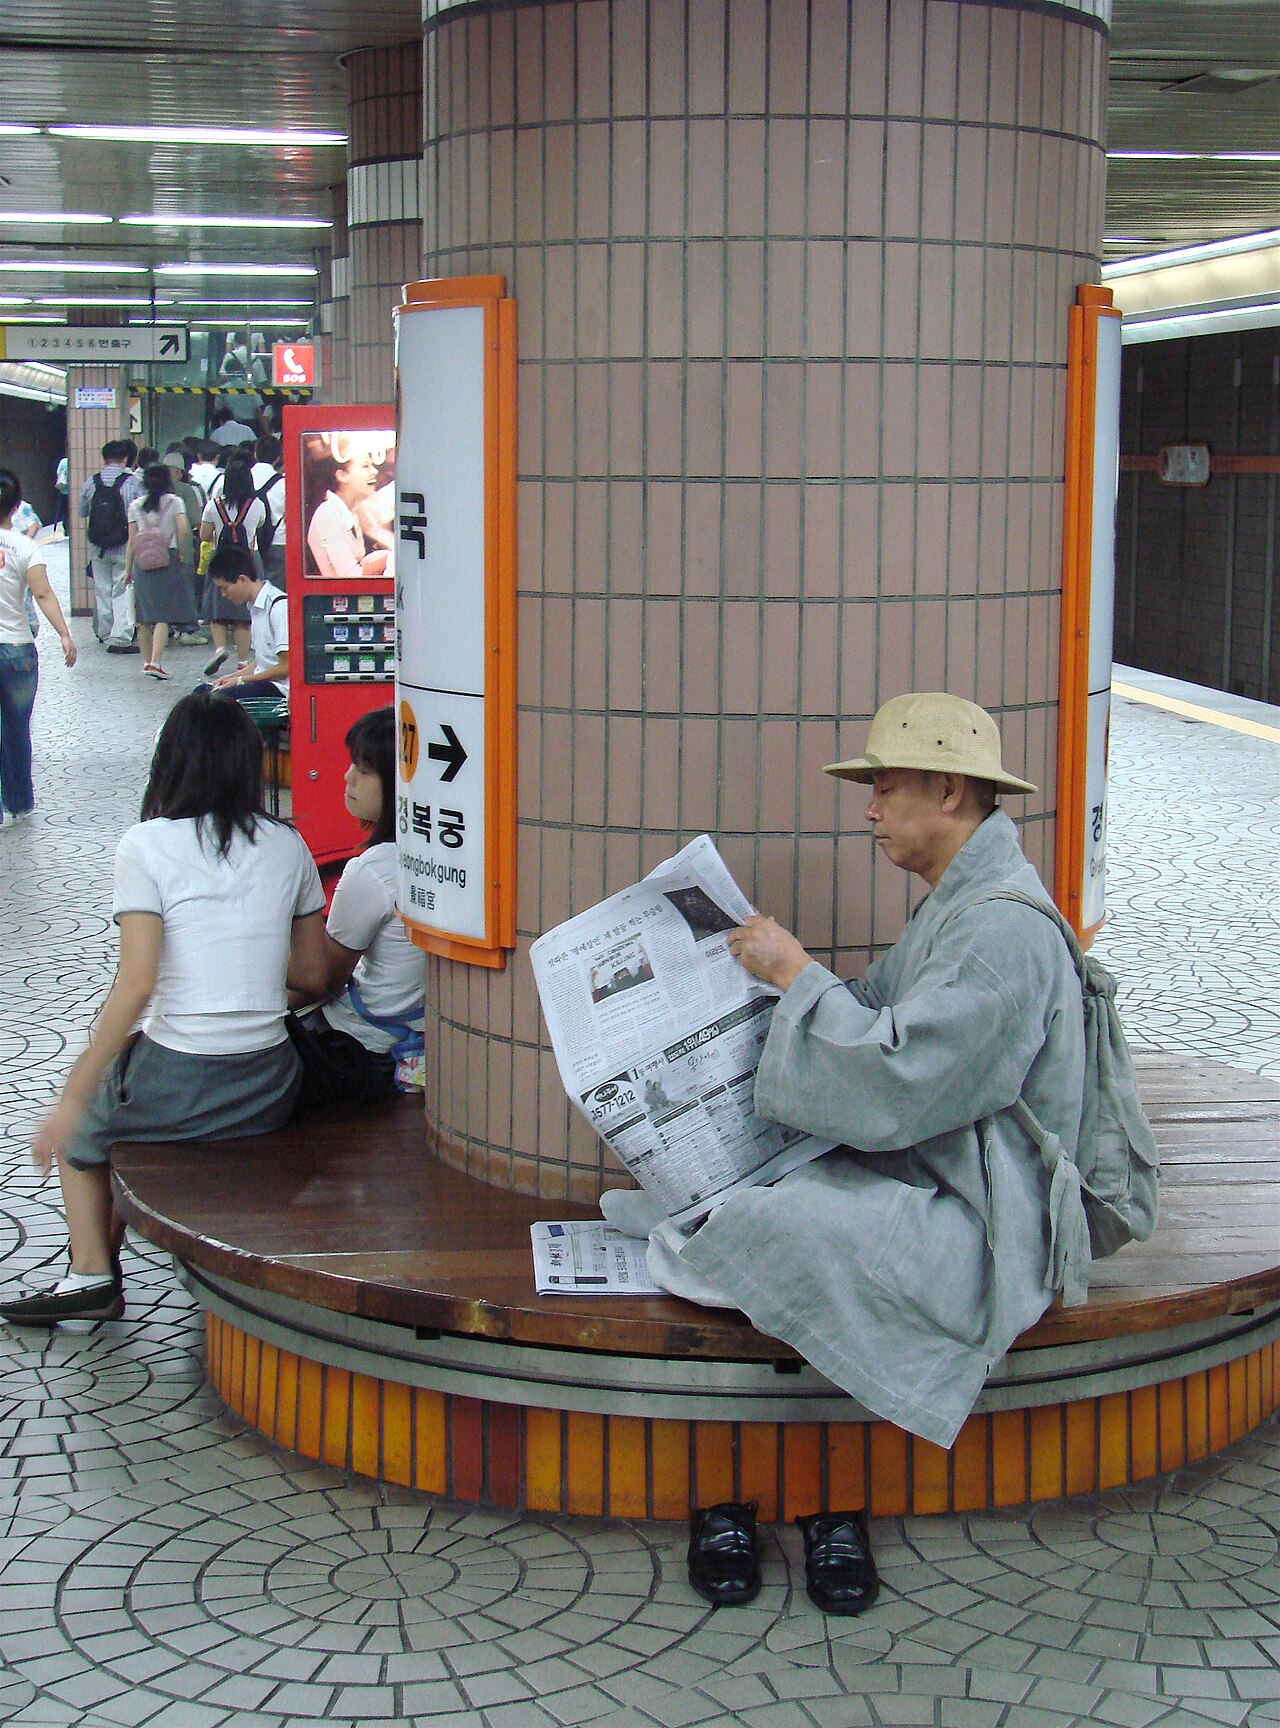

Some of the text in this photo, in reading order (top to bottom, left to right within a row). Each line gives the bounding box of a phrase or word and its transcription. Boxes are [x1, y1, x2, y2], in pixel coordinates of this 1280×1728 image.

[282, 373, 307, 383] SOS
[398, 796, 466, 849] 경복궁
[591, 1089, 635, 1120] 1577-1212
